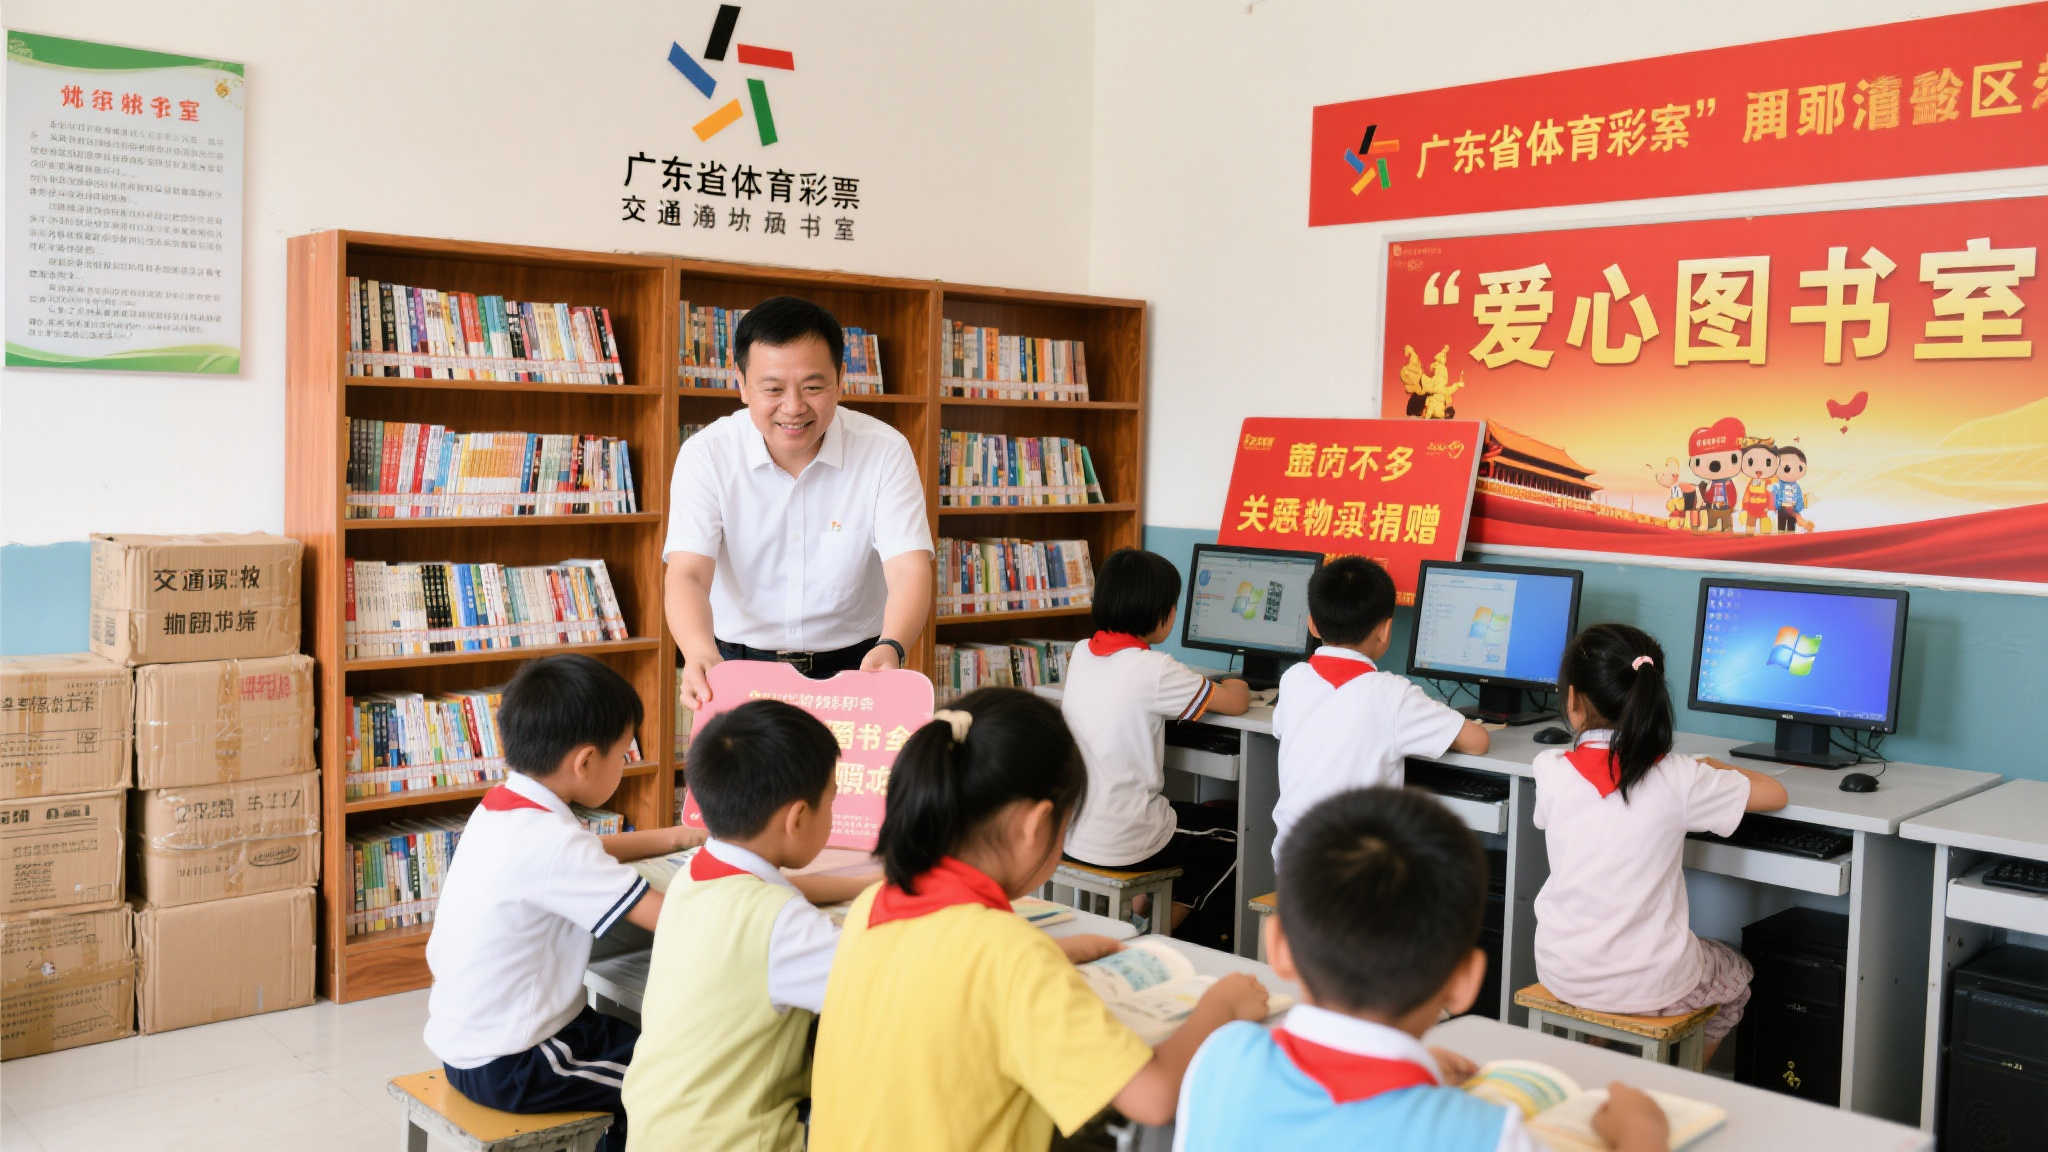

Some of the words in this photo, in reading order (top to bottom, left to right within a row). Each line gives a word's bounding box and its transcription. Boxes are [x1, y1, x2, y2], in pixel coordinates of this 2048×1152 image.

[1422, 237, 2037, 369] “爱心图书室
